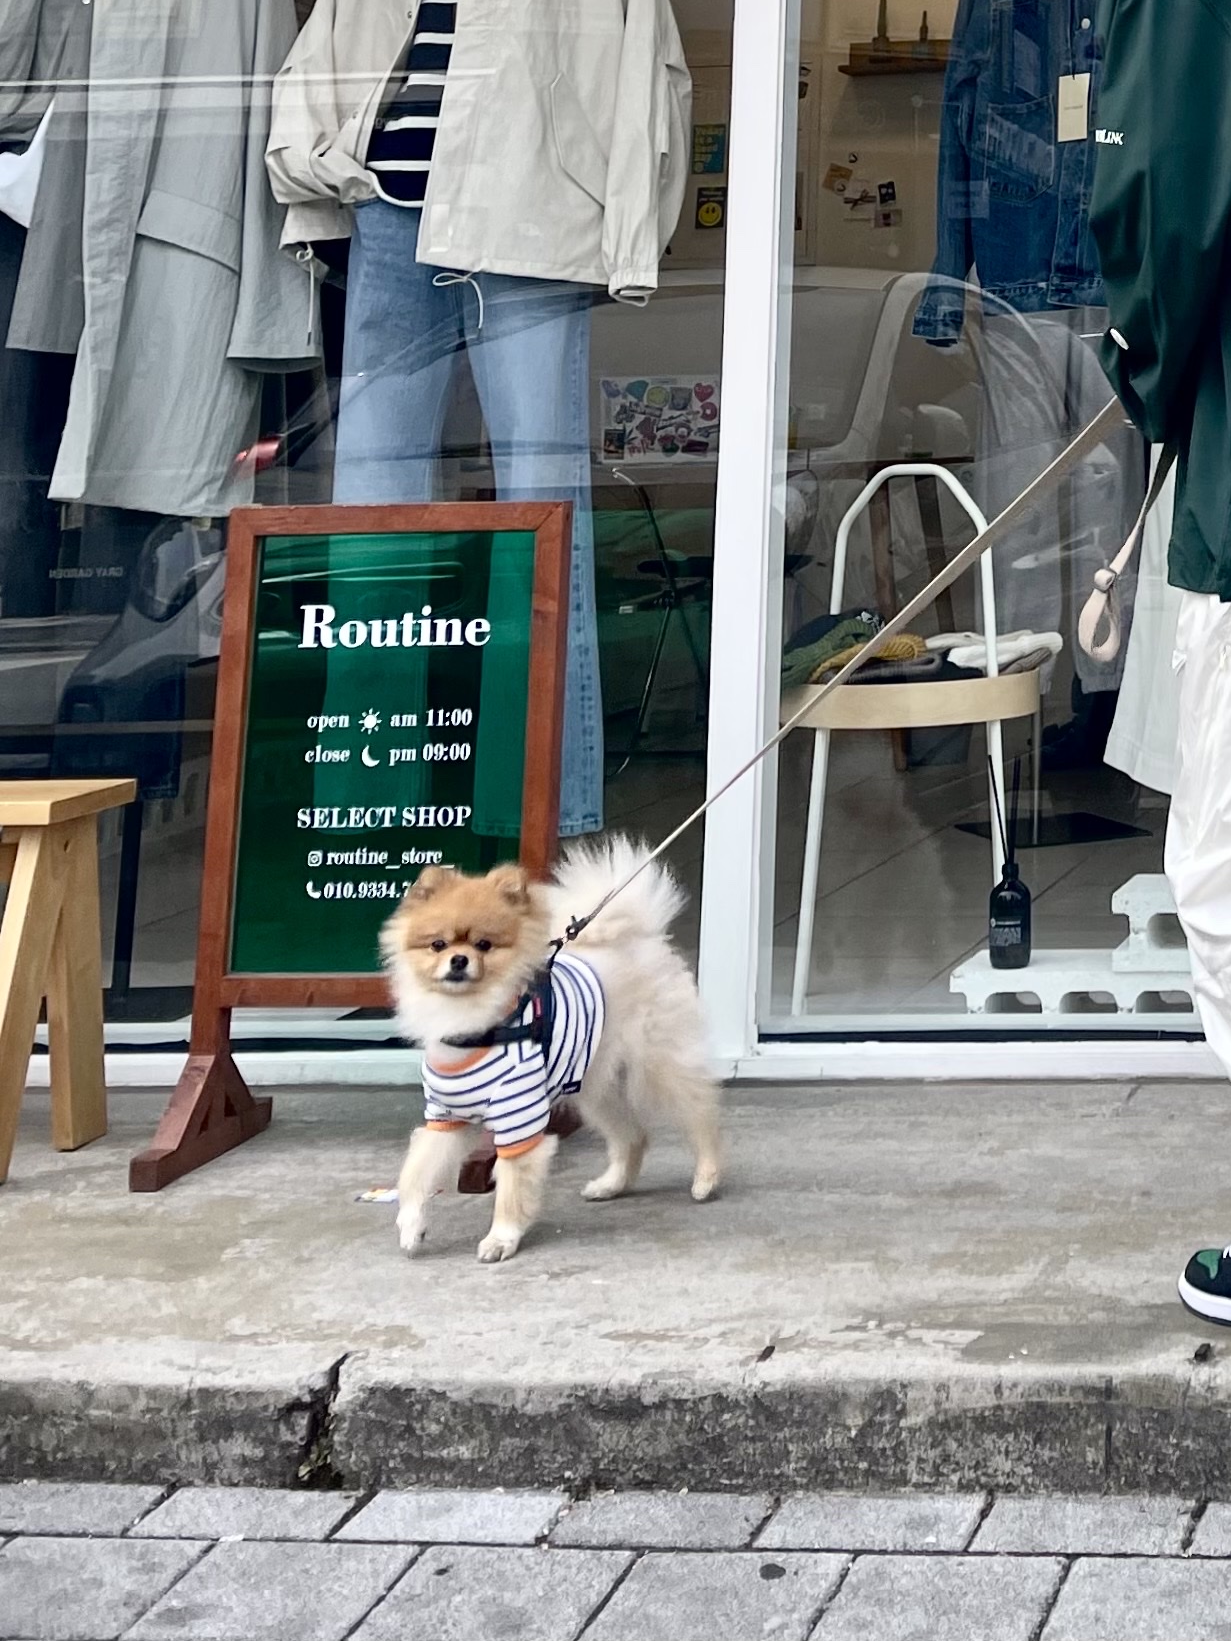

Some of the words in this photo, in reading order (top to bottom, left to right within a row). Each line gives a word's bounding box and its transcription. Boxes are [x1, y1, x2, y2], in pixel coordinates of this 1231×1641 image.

[297, 604, 491, 649] Routine
[306, 714, 350, 733] open
[390, 714, 418, 727] am
[425, 708, 473, 727] 11:00
[304, 744, 351, 763] close
[388, 748, 417, 766] pm
[422, 742, 471, 761] 09:00
[297, 806, 397, 829] SELECT
[401, 805, 472, 827] SHOP
[323, 881, 413, 900] 010.9334.7
